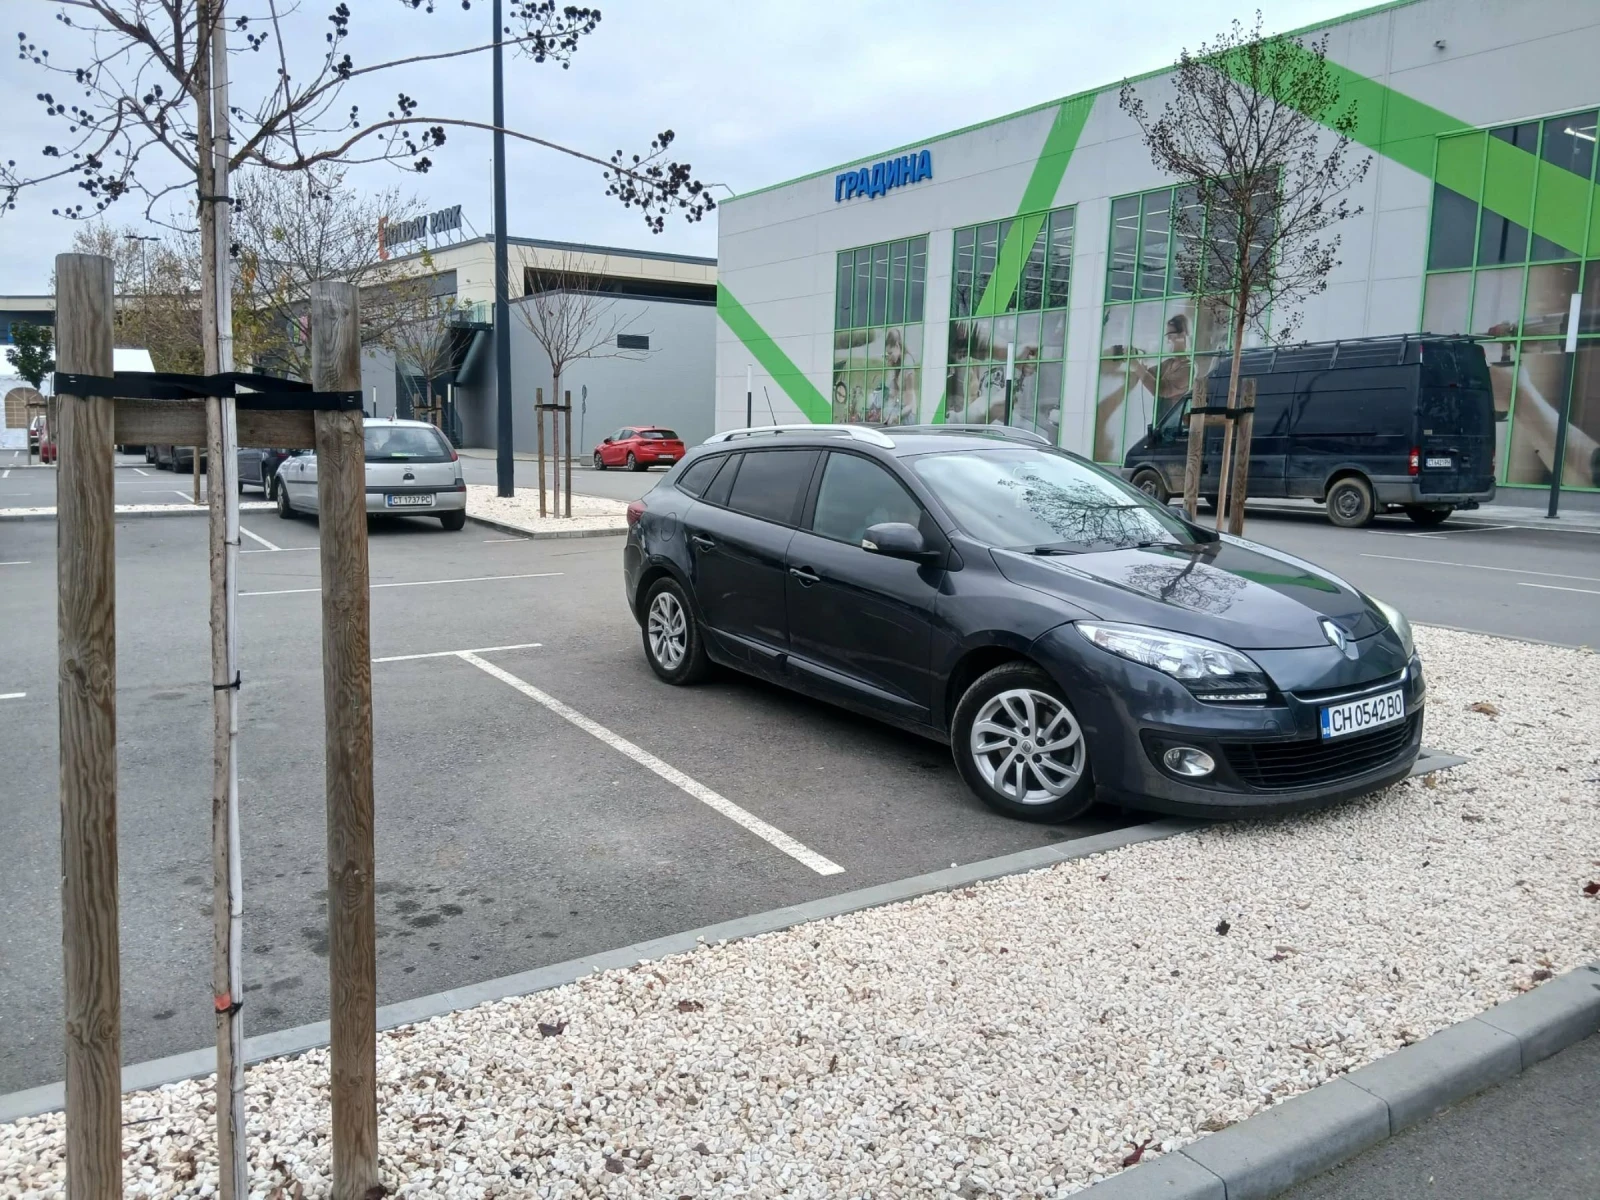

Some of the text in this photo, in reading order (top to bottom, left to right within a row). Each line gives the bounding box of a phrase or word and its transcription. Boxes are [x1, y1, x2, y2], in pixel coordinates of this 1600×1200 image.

[835, 150, 932, 203] ГРАДИНА
[430, 204, 462, 234] PARK
[404, 496, 420, 504] 1737
[1332, 706, 1353, 732] CH
[1355, 698, 1386, 727] 0542
